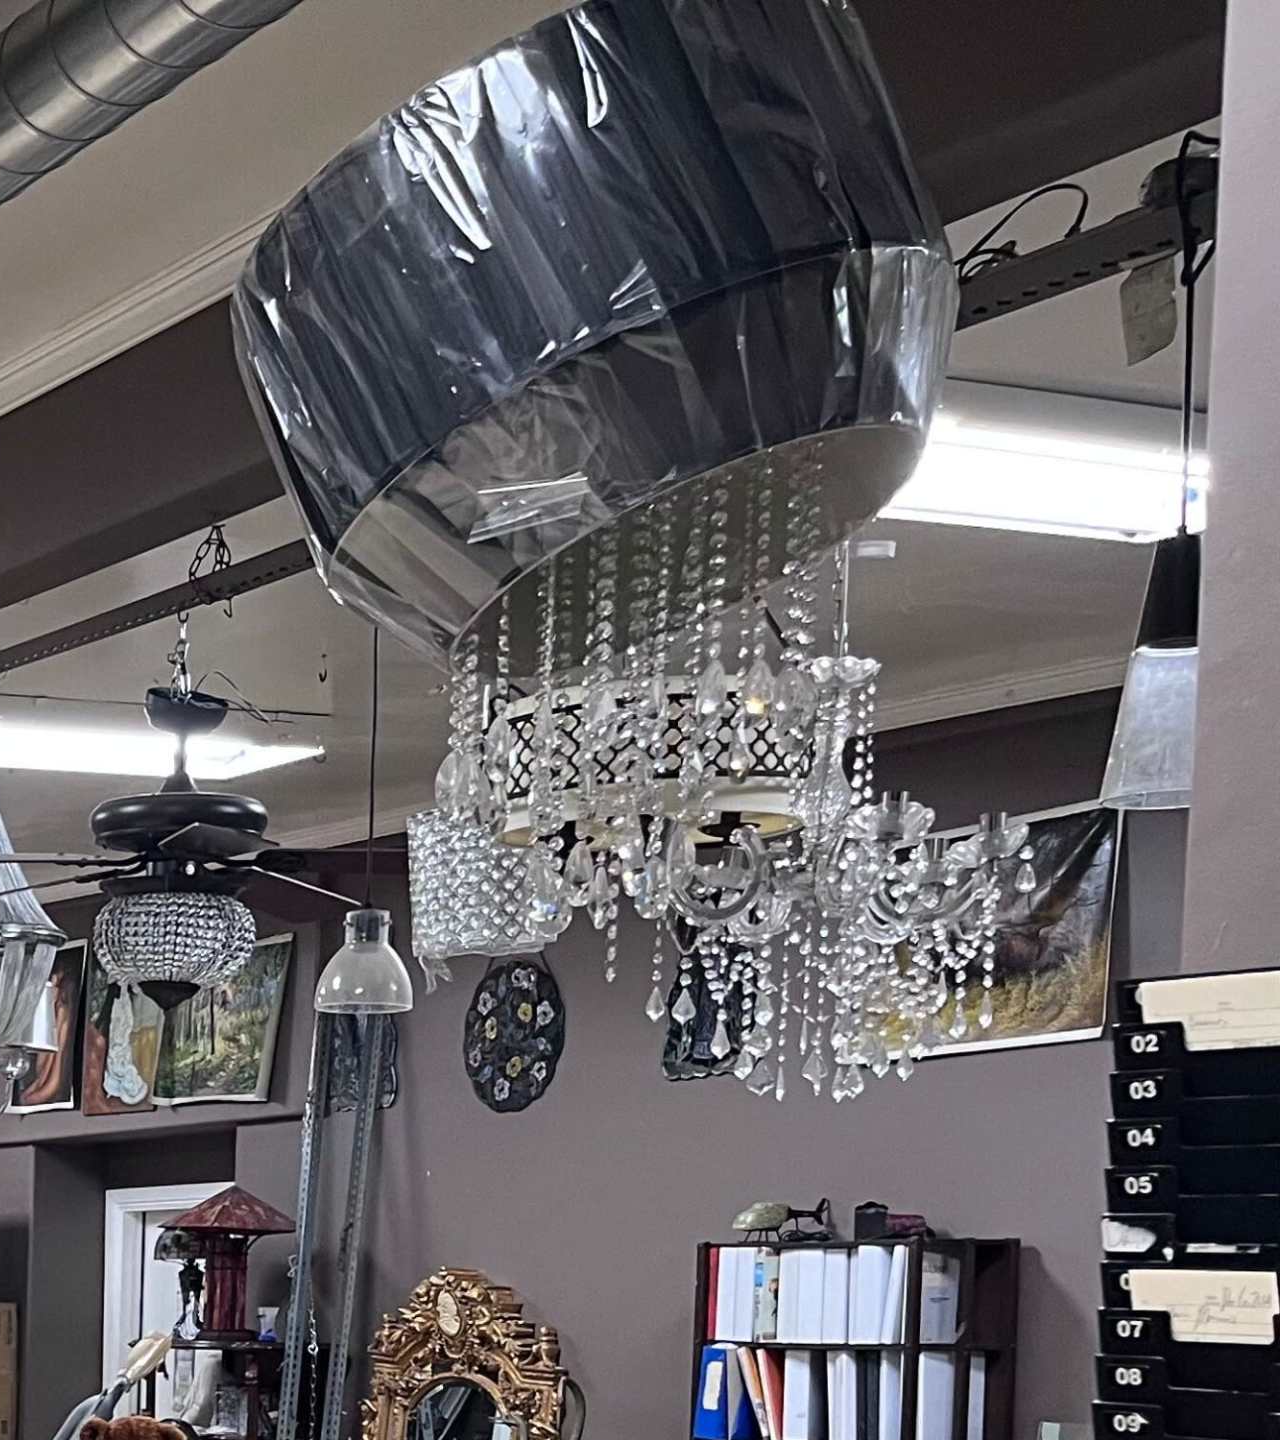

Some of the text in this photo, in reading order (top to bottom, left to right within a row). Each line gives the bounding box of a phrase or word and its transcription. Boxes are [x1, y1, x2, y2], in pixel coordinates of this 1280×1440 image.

[1130, 1034, 1159, 1053] 02
[1129, 1081, 1157, 1099] 03
[1126, 1129, 1155, 1147] 04
[1124, 1176, 1153, 1194] 05
[1116, 1320, 1144, 1338] 07
[1115, 1367, 1142, 1386] 08
[1113, 1414, 1140, 1432] 09
